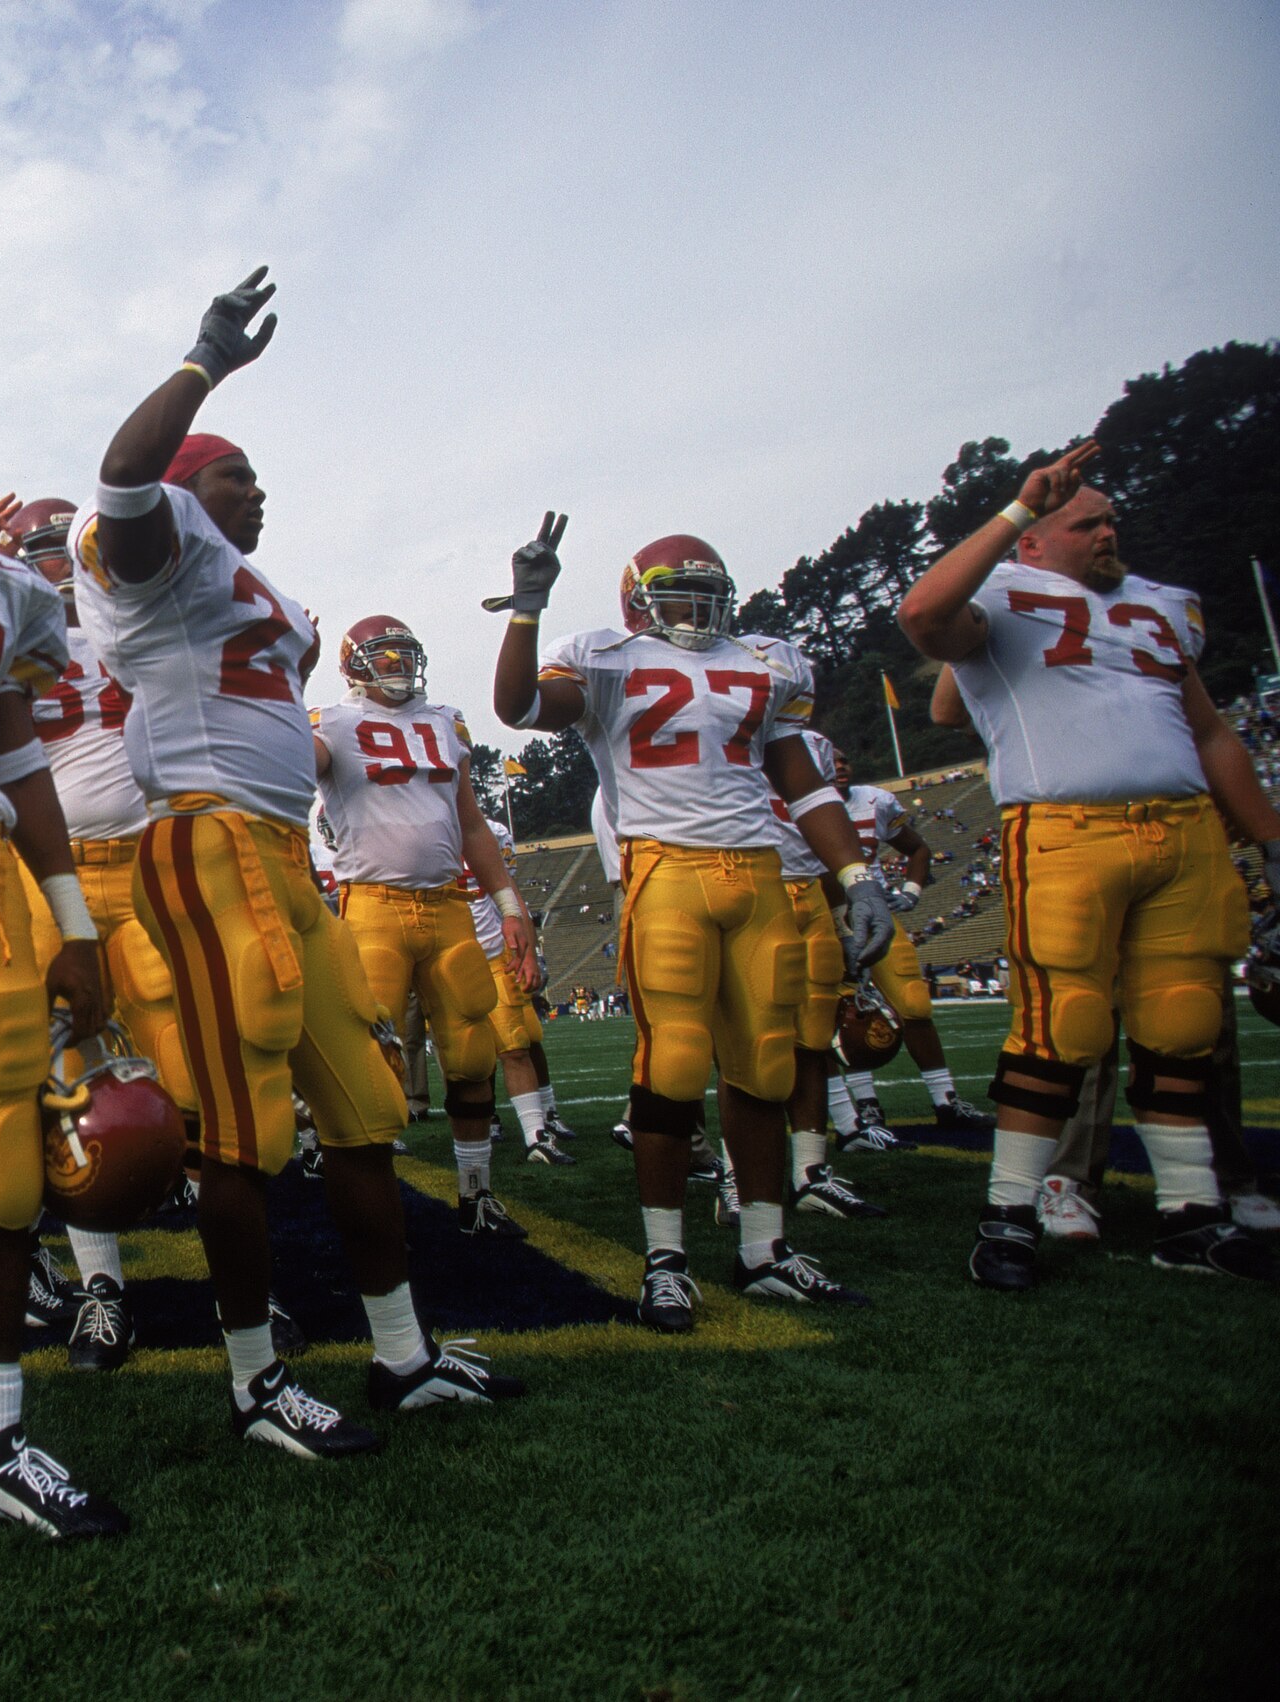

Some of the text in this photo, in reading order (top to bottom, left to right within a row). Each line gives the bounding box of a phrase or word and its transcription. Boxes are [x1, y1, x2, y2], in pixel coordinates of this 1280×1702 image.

[1007, 590, 1189, 684] 73
[355, 720, 455, 787] 91
[625, 667, 772, 770] 27
